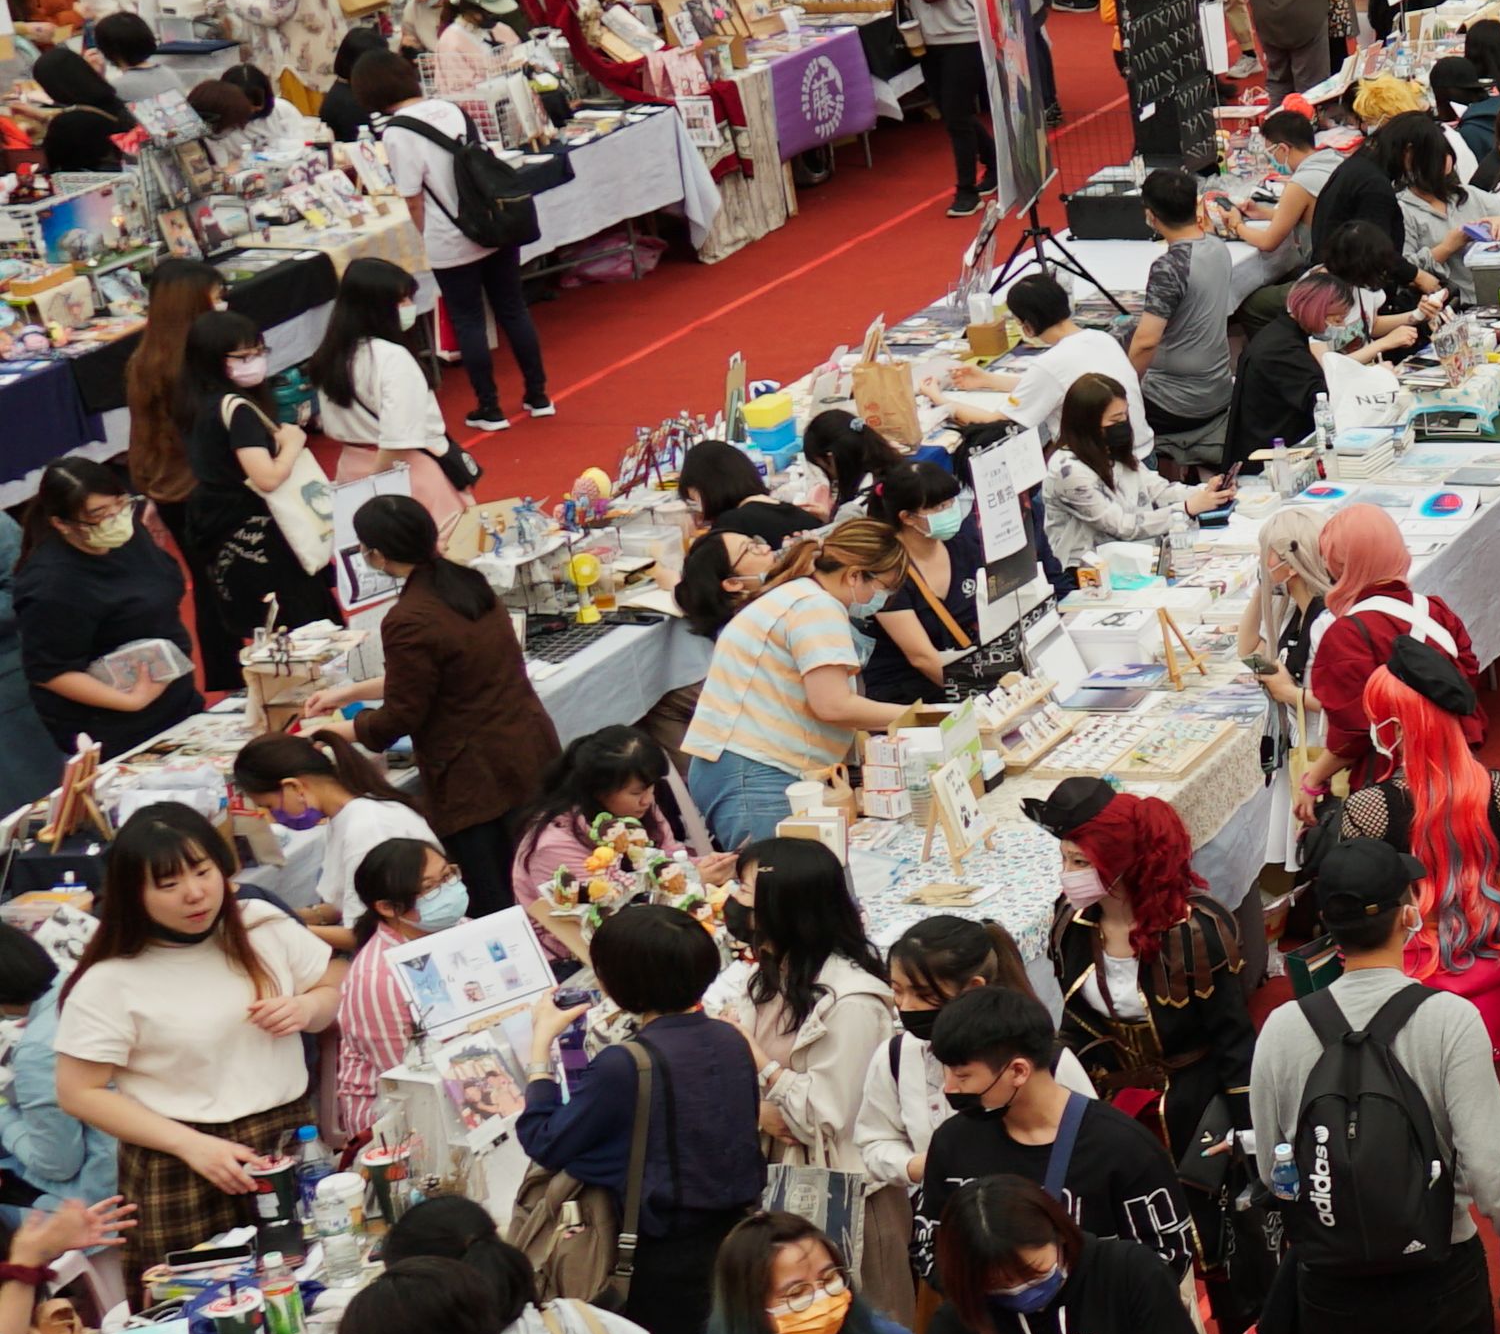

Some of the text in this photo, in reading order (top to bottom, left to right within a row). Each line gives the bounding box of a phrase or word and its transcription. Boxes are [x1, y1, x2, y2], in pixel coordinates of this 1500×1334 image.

[1354, 390, 1400, 406] NET
[986, 485, 1015, 509] 已售完
[1309, 1145, 1336, 1228] adidas
